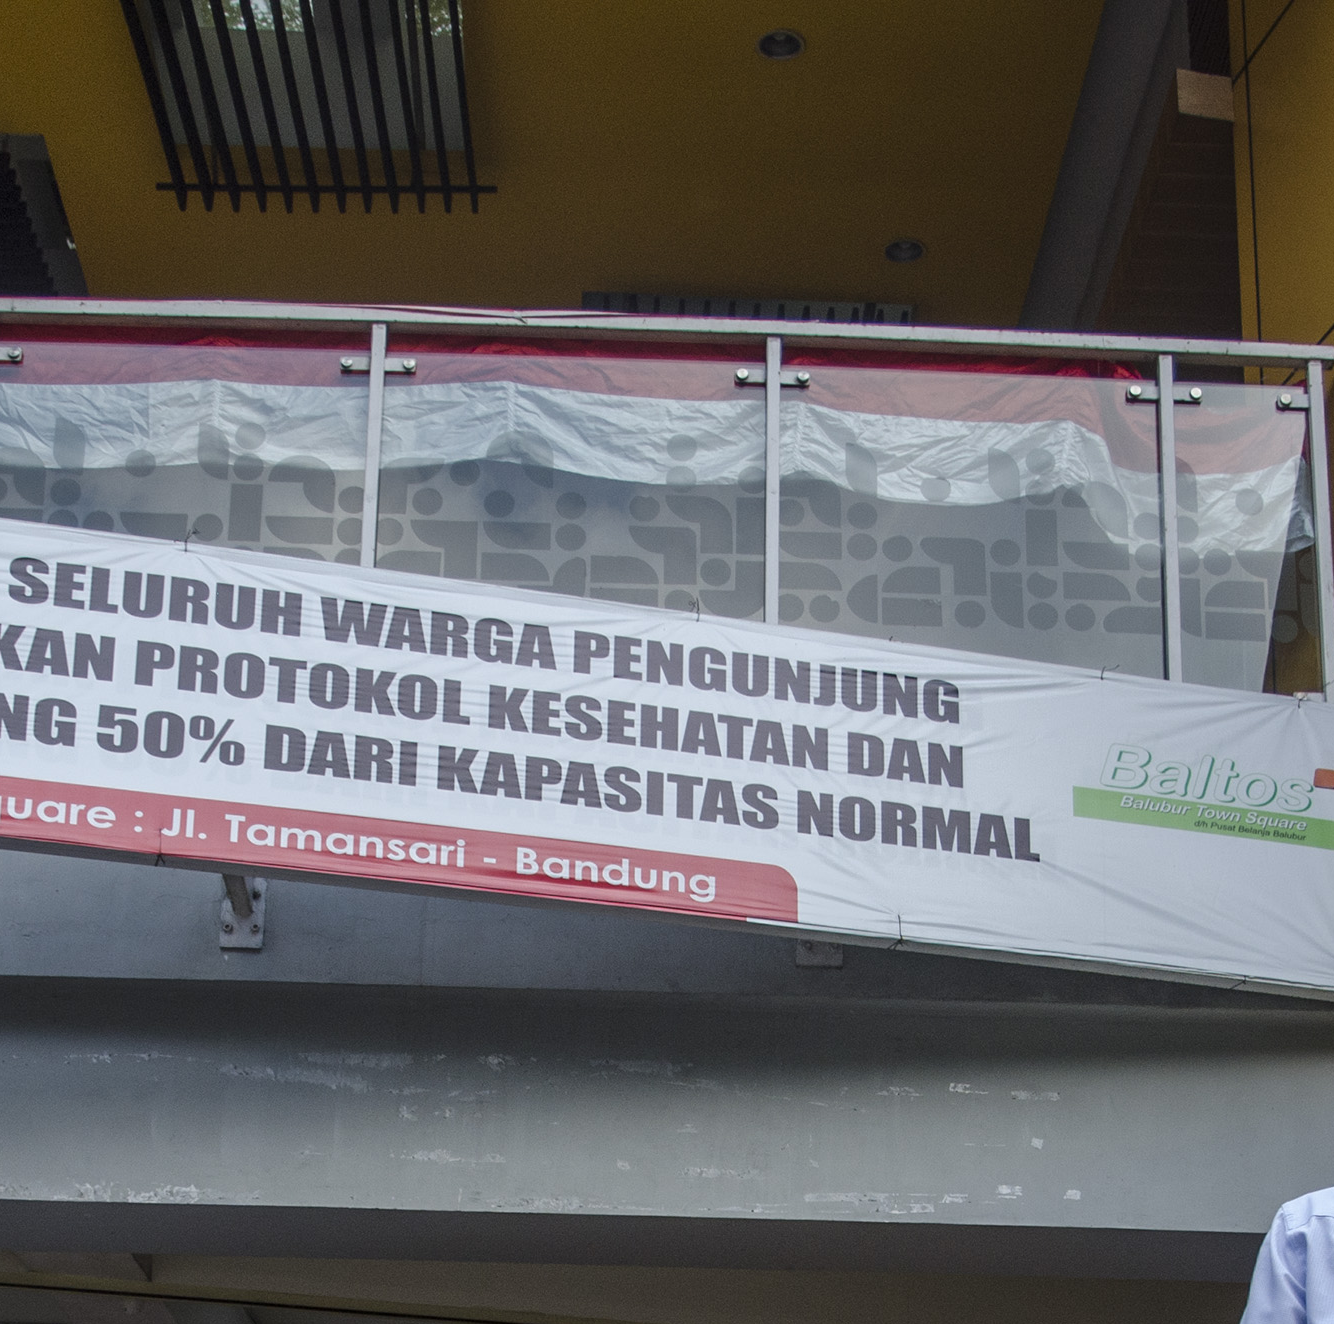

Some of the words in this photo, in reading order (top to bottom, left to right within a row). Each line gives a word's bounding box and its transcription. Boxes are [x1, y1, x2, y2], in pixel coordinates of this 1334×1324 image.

[7, 557, 303, 637] SELURUH
[320, 596, 557, 670] WARGA
[573, 630, 961, 724] PENGUNJUNG
[134, 640, 471, 725] PROTOKOL
[488, 684, 829, 771] KESEHATAN
[847, 732, 964, 788] DAN
[97, 705, 246, 766] 50%
[264, 724, 418, 787] DARI
[437, 745, 780, 830] KAPASITAS
[797, 790, 1040, 862] NORMAL
[1100, 742, 1314, 813] Baltos
[1120, 795, 1191, 817] Balubur
[1196, 804, 1241, 825] Town
[1245, 811, 1308, 832] Square
[160, 807, 207, 840] Jl.
[225, 814, 466, 868] Tamansari
[516, 847, 717, 903] Bandung
[1210, 822, 1236, 832] Pusat
[1237, 824, 1271, 838] Belanja
[1272, 829, 1307, 842] Balubur
